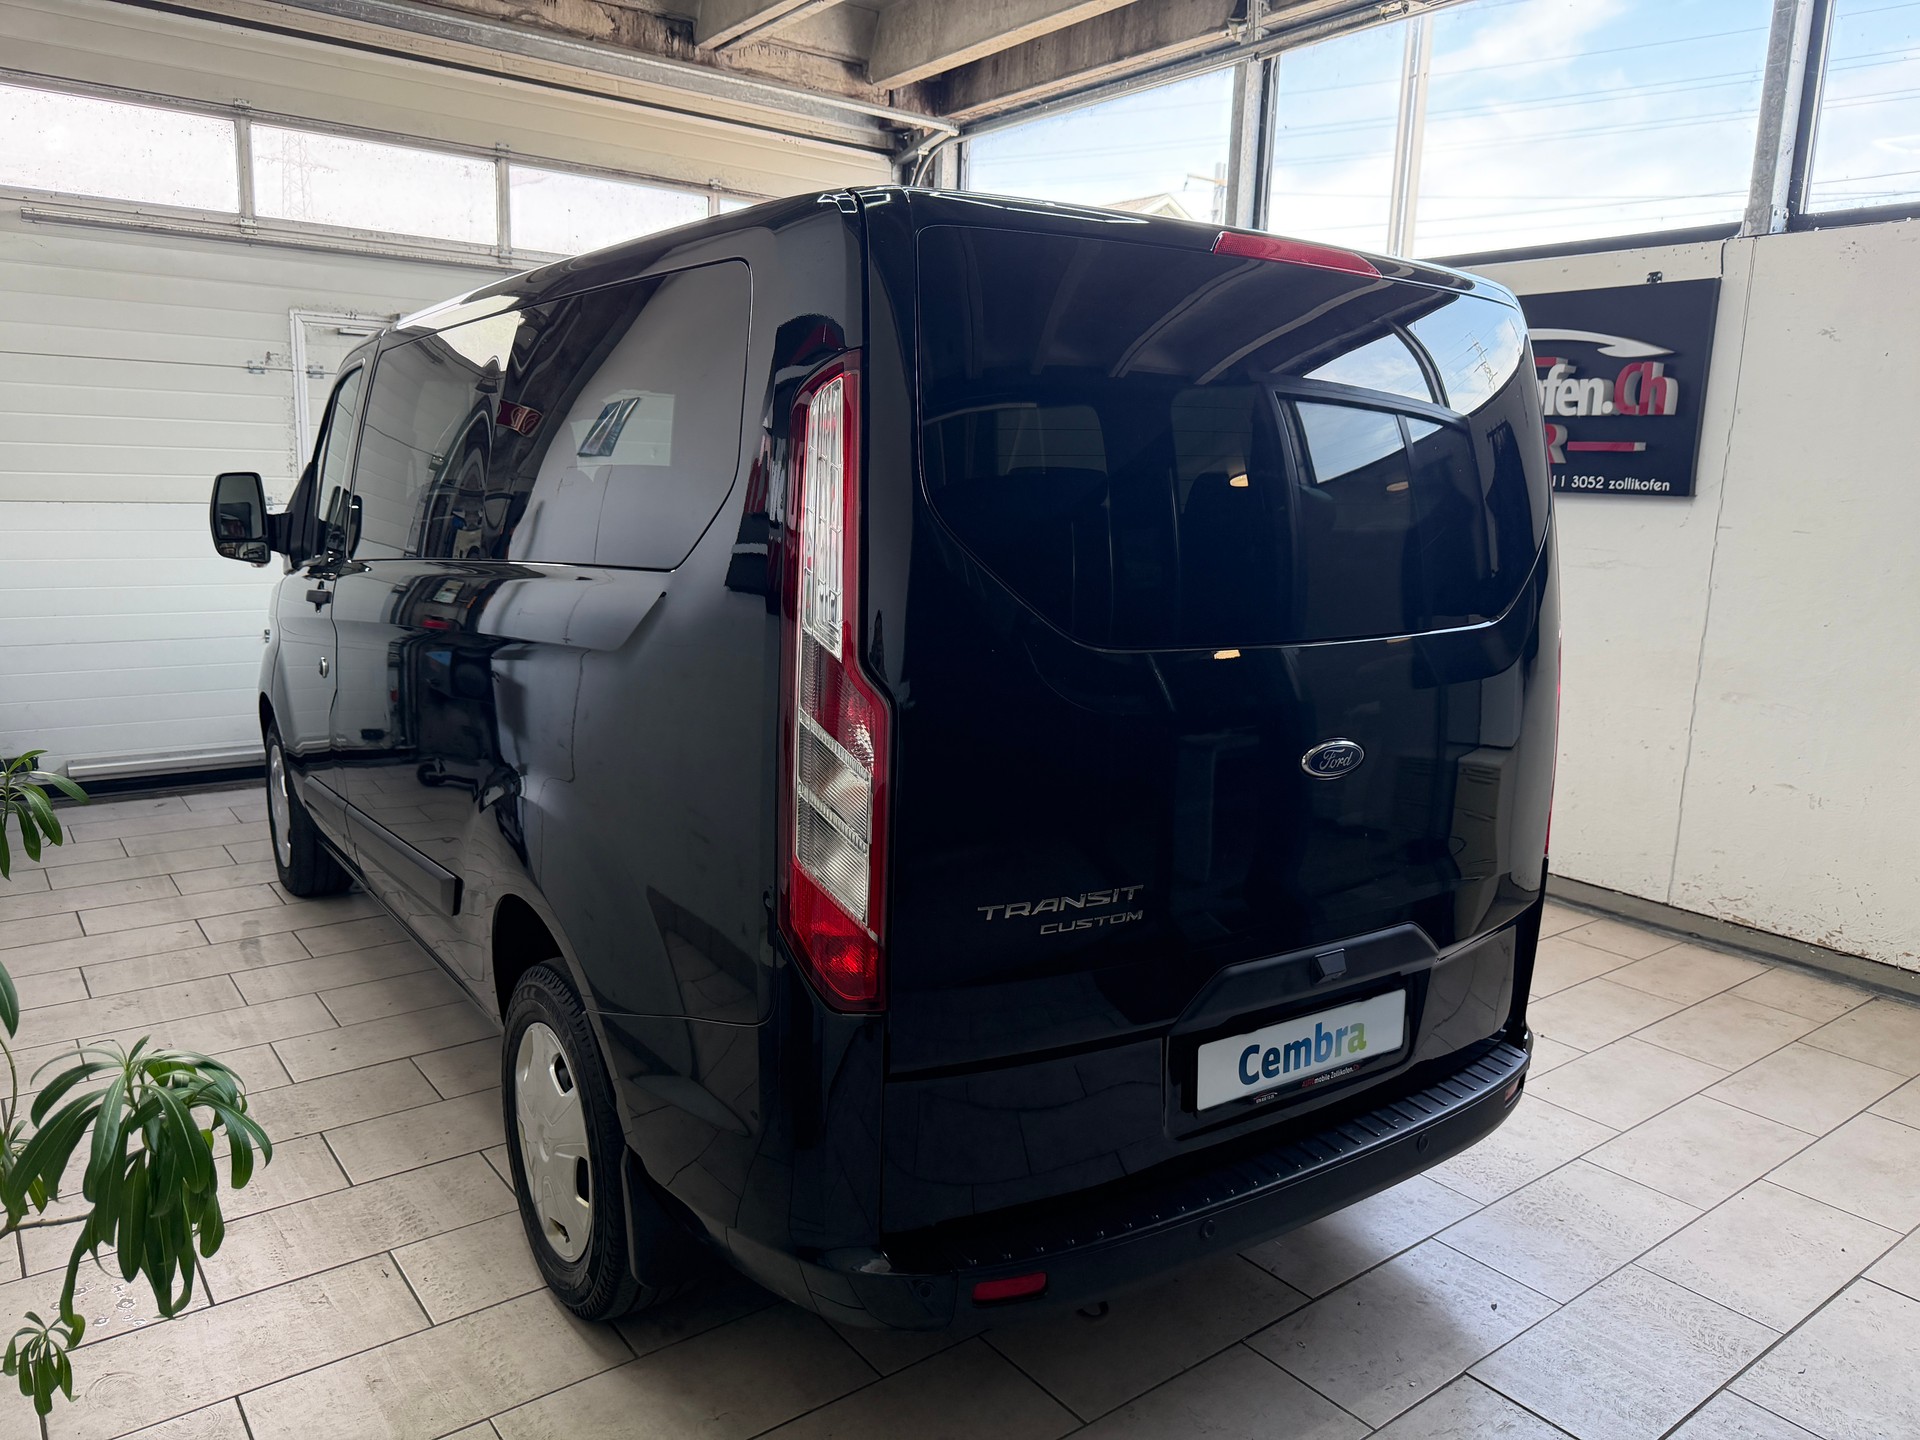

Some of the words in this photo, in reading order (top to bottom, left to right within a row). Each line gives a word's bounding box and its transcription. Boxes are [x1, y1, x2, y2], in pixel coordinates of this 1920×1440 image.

[1537, 361, 1679, 417] fen.Ch
[1571, 475, 1605, 489] 3052
[1608, 477, 1670, 491] zollikofen
[1319, 748, 1354, 770] Ford
[977, 884, 1144, 921] TRANSIT
[1040, 910, 1144, 935] CUSTOM
[1238, 1022, 1367, 1086] Cembra
